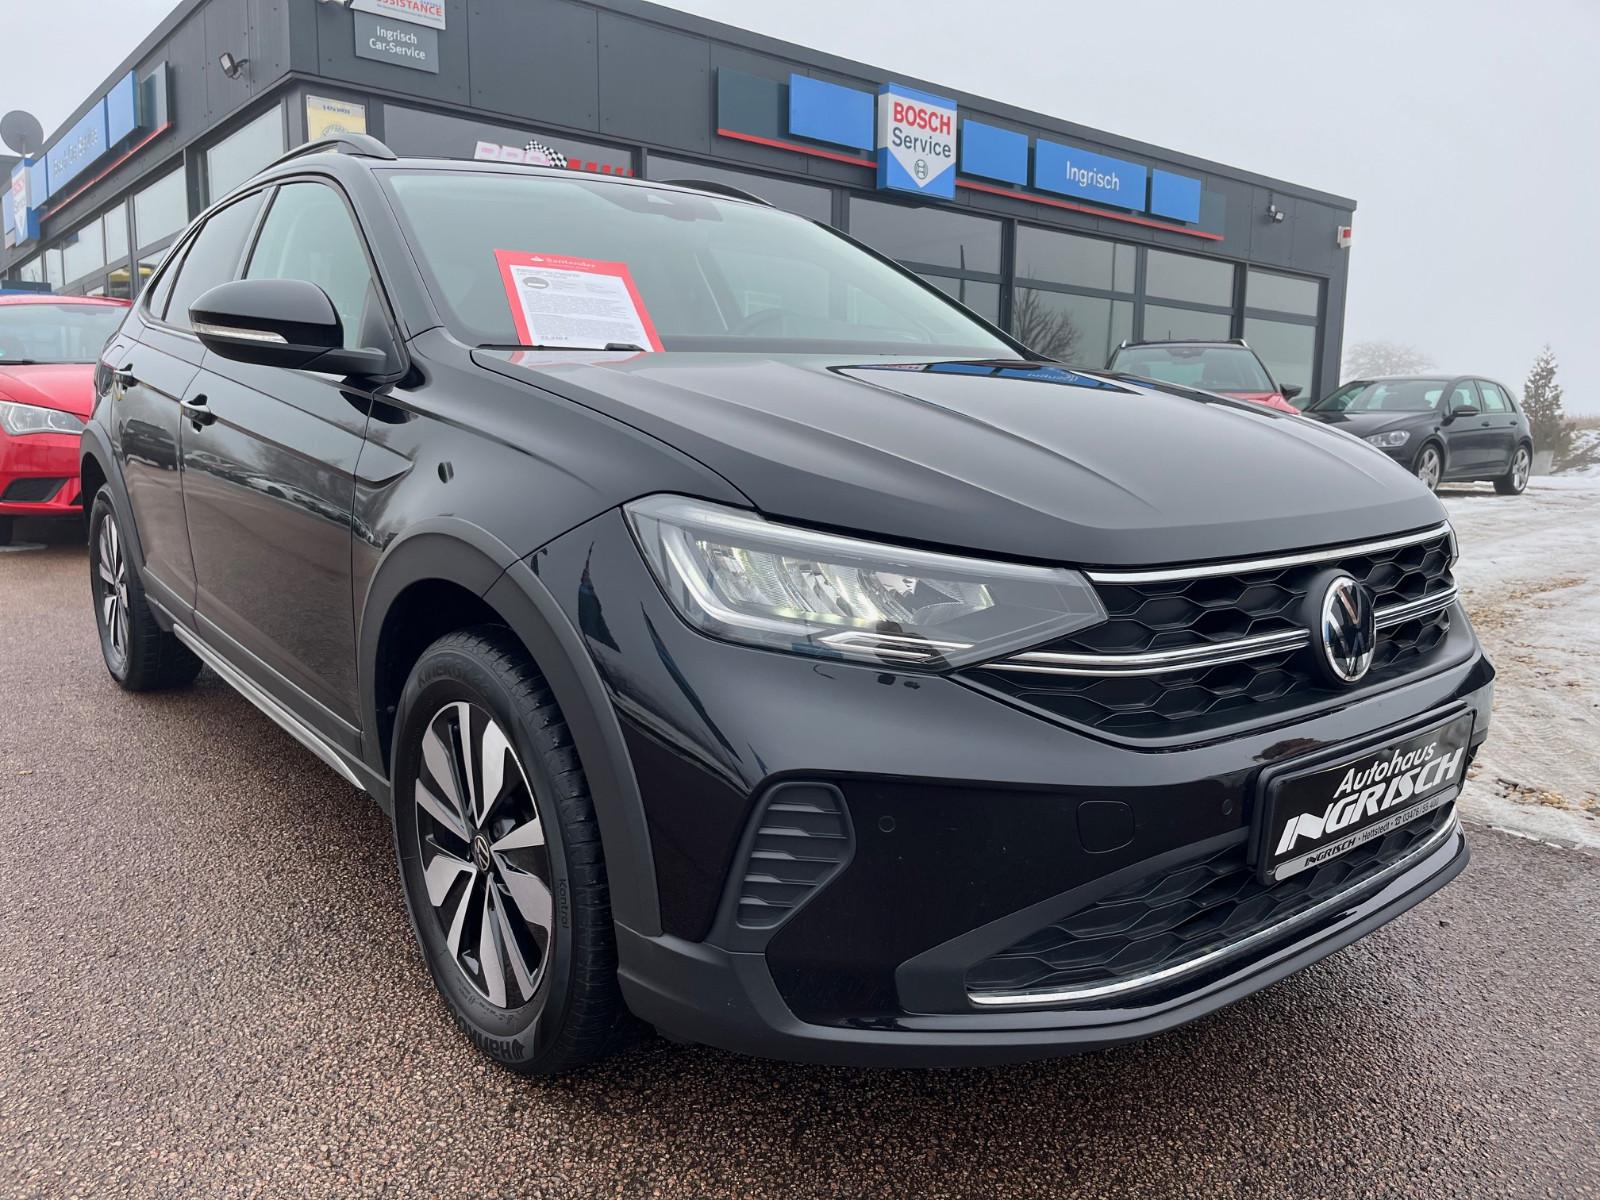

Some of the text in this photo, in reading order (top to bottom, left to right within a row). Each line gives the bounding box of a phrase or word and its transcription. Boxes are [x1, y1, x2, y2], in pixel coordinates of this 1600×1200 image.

[369, 38, 426, 60] Car-Service
[376, 25, 417, 44] Ingrisch
[893, 101, 951, 135] BOSCH
[892, 126, 952, 158] Service
[1066, 160, 1120, 192] Ingrisch
[1332, 742, 1437, 799] Autohaus
[1274, 747, 1464, 857] INGRISCH
[1304, 837, 1357, 867] INGRISCH
